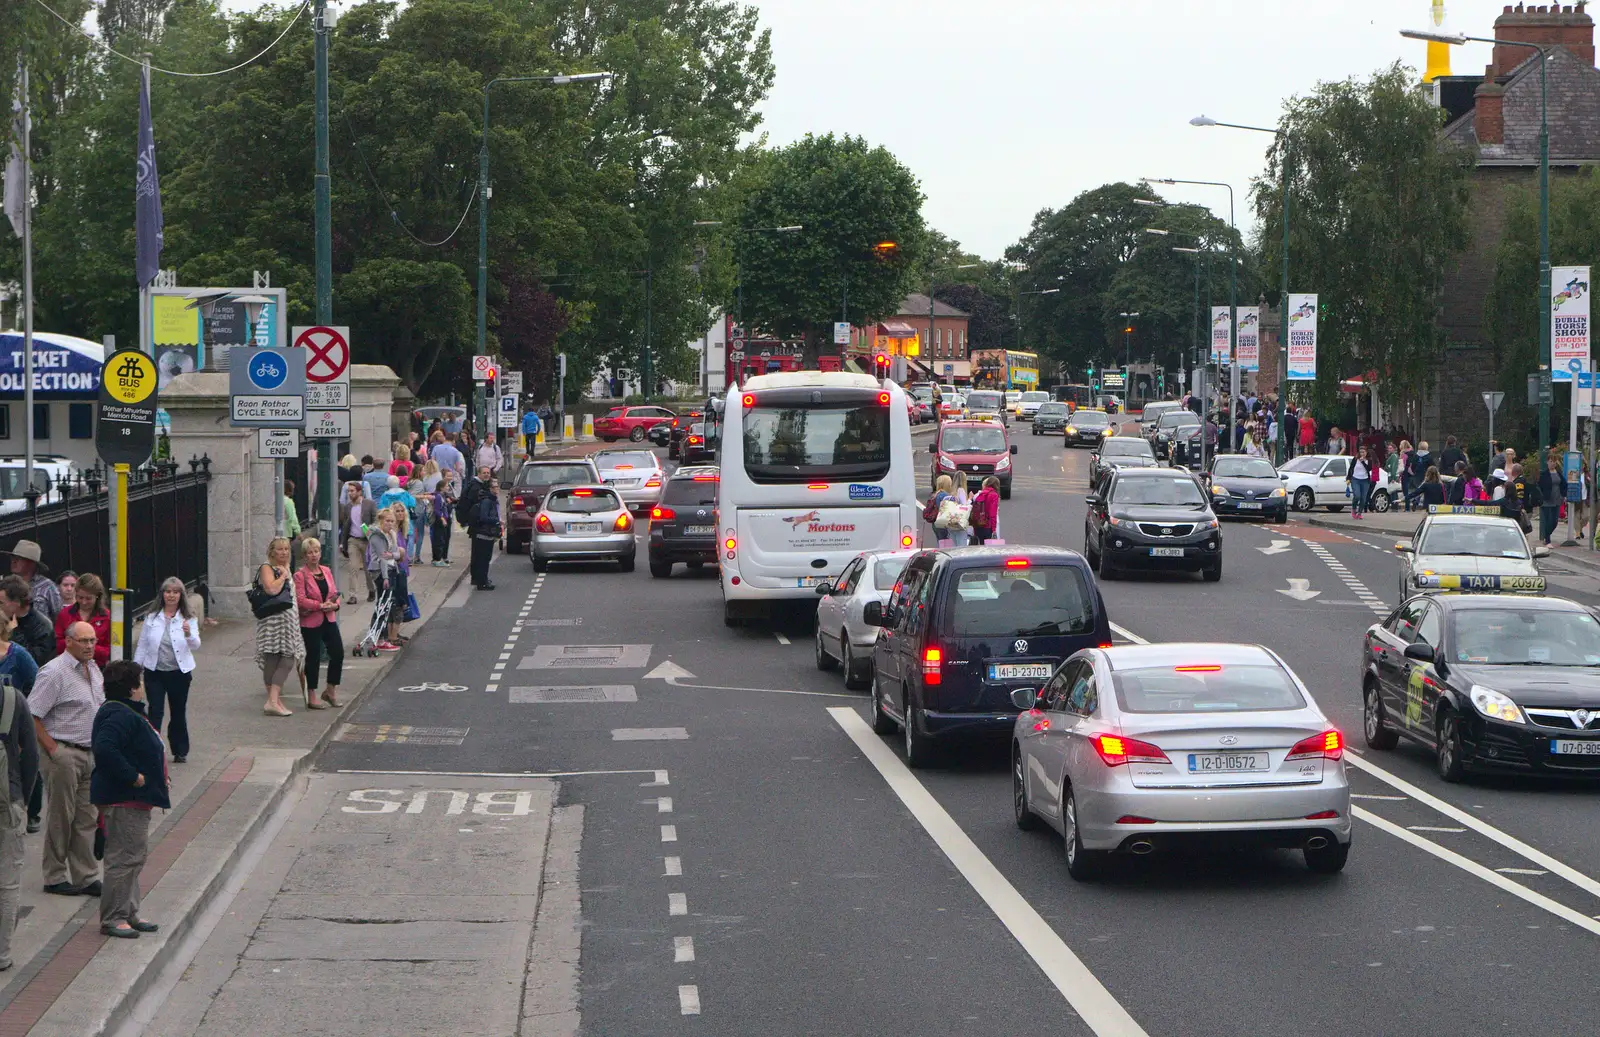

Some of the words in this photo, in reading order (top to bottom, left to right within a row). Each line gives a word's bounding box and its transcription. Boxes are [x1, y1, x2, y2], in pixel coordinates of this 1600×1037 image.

[1555, 329, 1587, 337] SHOW
[119, 378, 140, 388] BUS
[123, 391, 136, 399] 486
[807, 523, 855, 533] Mortons
[1420, 576, 1428, 585] D
[1467, 576, 1494, 588] TAXI
[1511, 577, 1544, 588] 20972
[998, 667, 1048, 677] 141-D-23703
[1201, 756, 1256, 769] 12-D-10572
[340, 789, 534, 816] BUS
